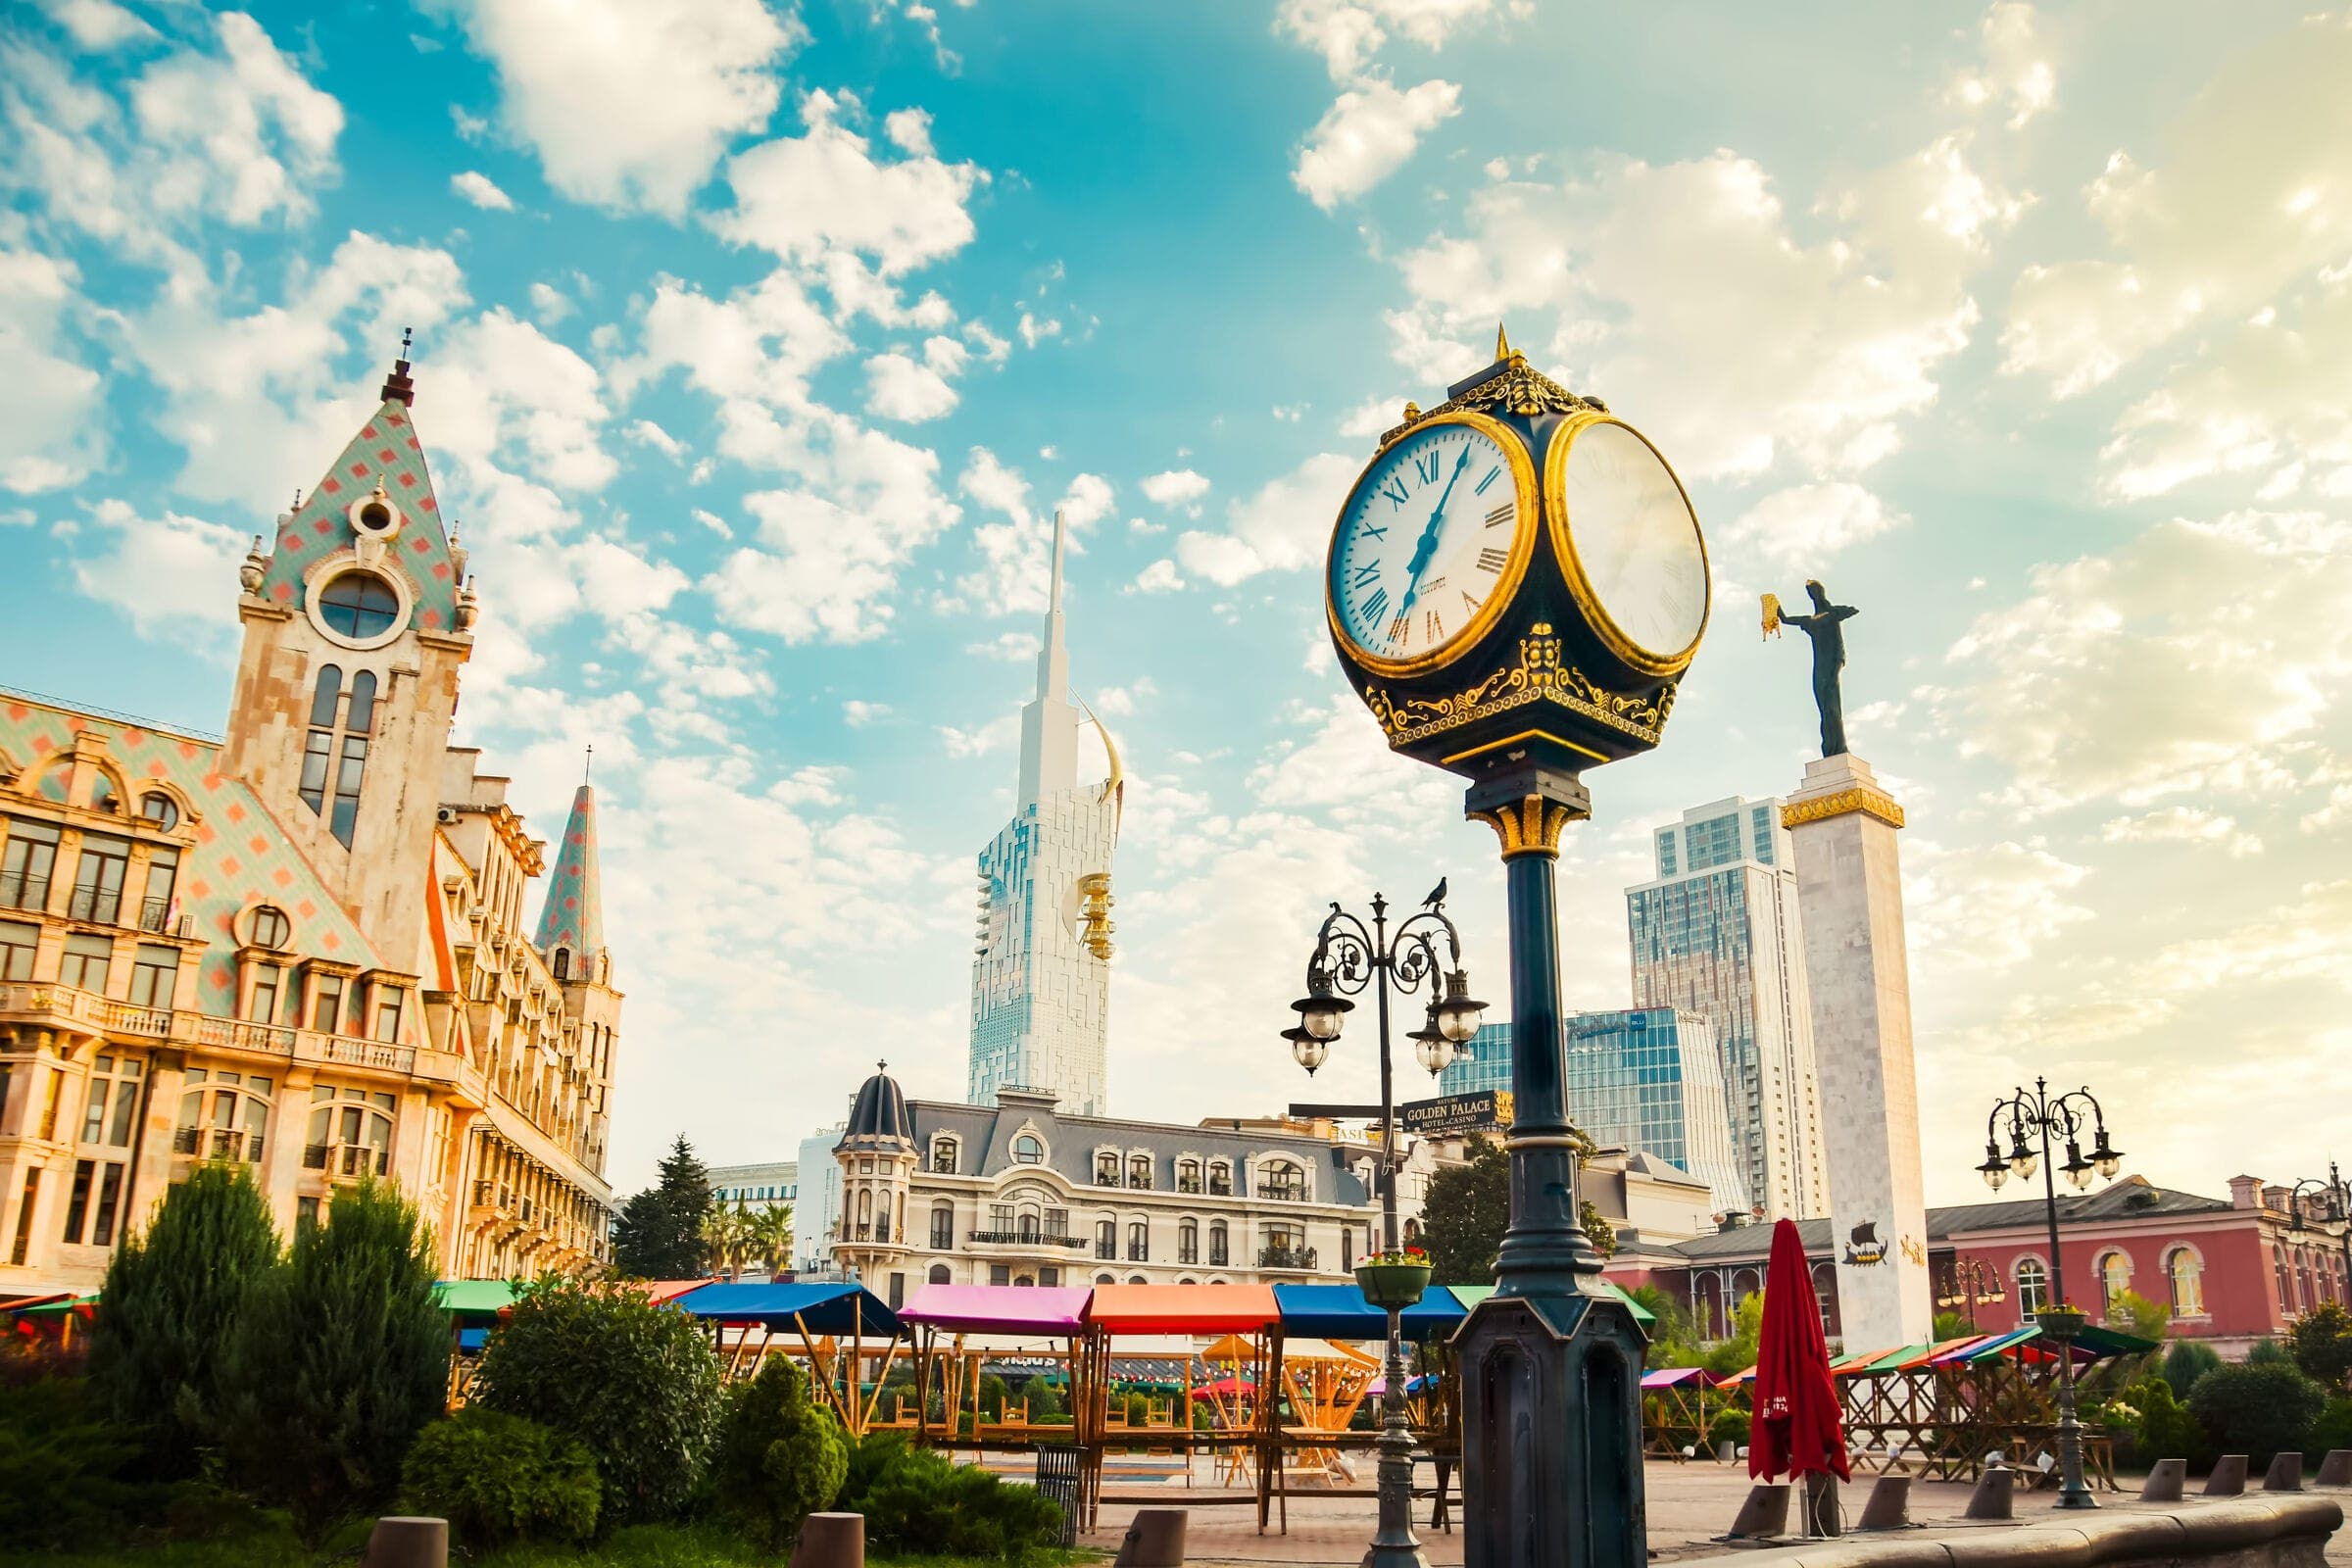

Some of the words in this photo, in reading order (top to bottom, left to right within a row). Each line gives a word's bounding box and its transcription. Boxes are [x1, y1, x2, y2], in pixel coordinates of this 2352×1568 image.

[1415, 450, 1440, 490] XII
[1474, 466, 1501, 496] II
[1383, 476, 1409, 513] XI
[1485, 502, 1514, 529] III
[1361, 522, 1388, 542] X
[1354, 559, 1380, 589] IX
[1360, 586, 1390, 630] VIII
[1461, 590, 1483, 619] V
[1426, 609, 1445, 645] VI
[1407, 1105, 1447, 1121] GOLDEN
[1450, 1100, 1490, 1115] PALACE
[1422, 1115, 1477, 1128] HOTEL-CASINO
